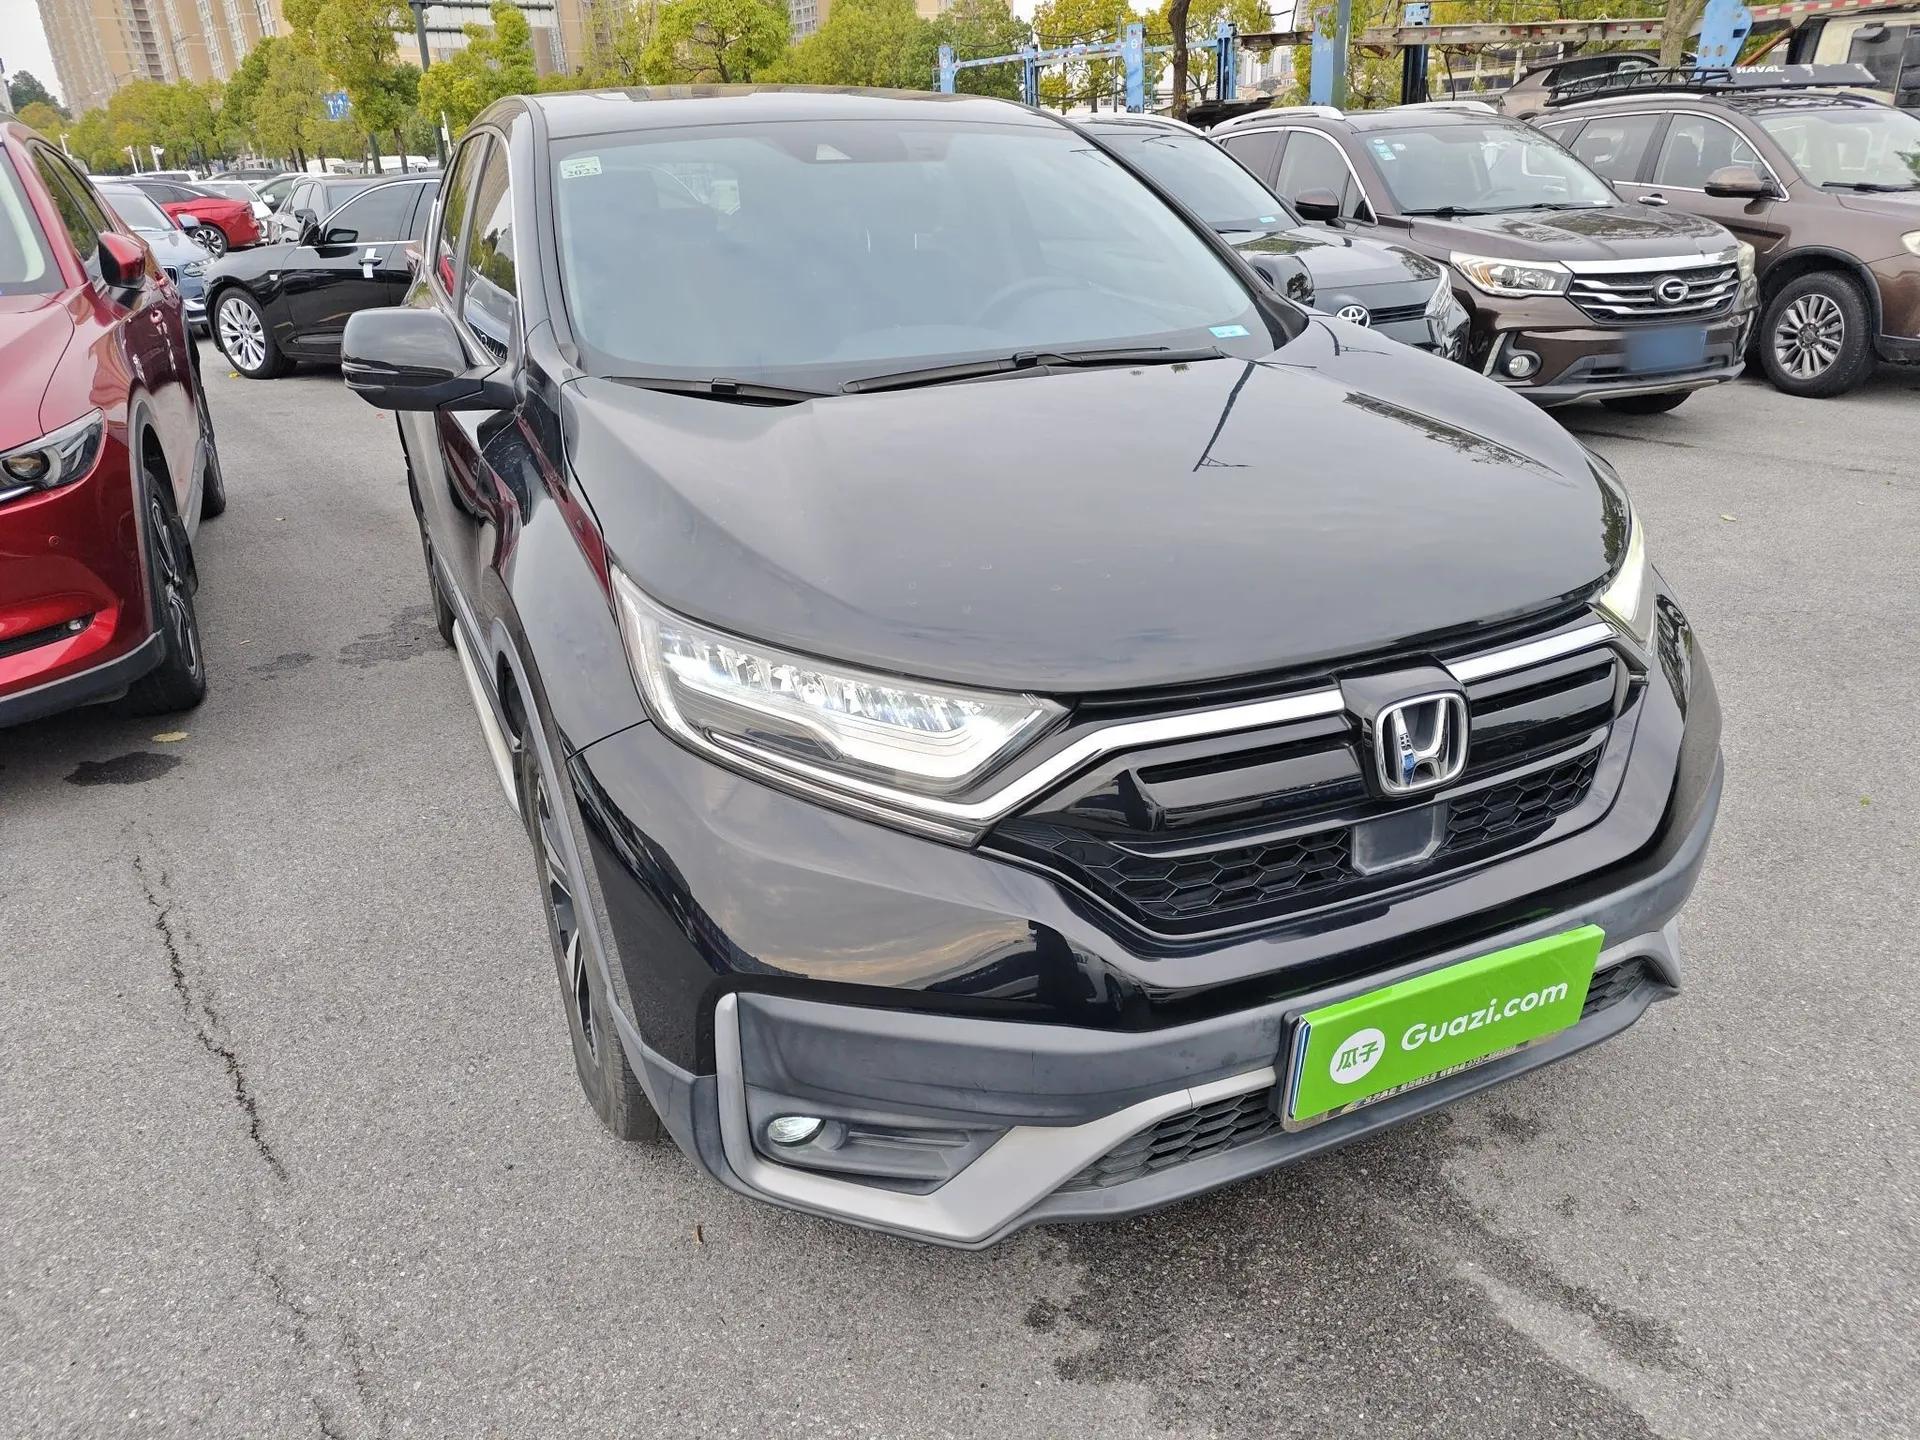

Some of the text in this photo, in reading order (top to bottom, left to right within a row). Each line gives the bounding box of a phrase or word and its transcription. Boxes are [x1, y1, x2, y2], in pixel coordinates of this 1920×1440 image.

[1736, 64, 1784, 74] HAVAL
[1401, 982, 1568, 1051] Guazi.com
[1336, 1040, 1379, 1072] 瓜子
